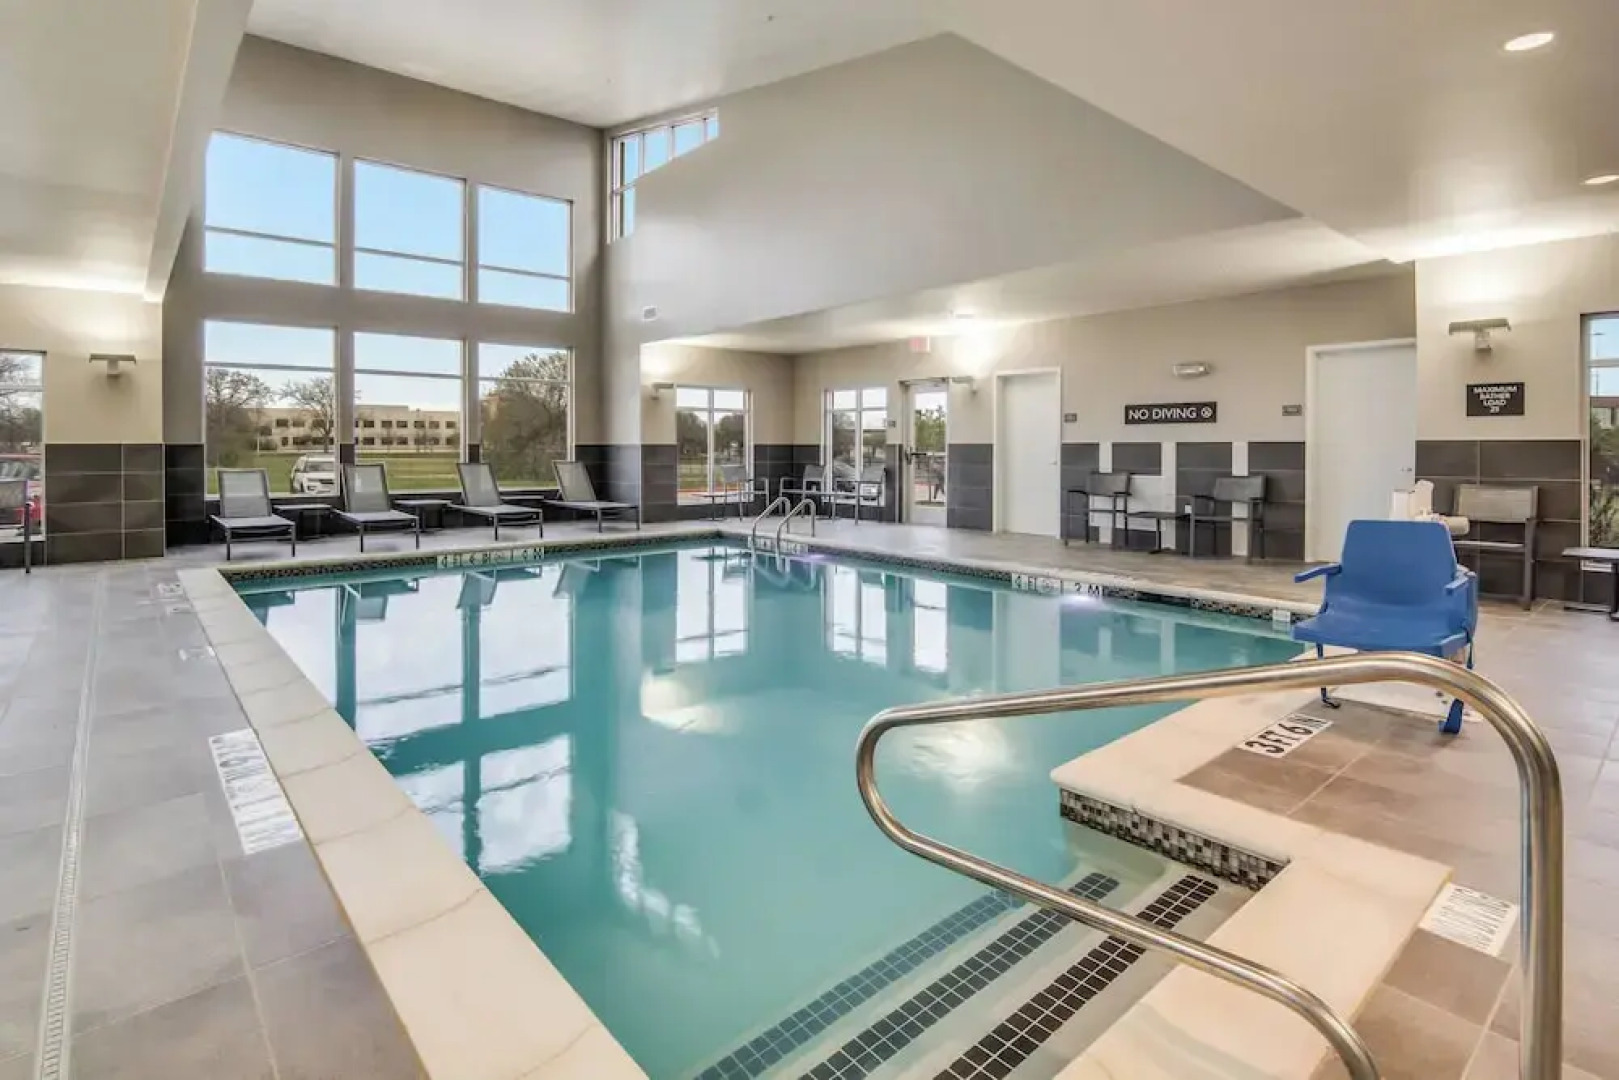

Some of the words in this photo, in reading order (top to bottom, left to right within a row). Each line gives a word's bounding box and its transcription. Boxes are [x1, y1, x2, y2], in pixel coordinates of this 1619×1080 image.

[1473, 385, 1518, 394] MAXIMUM
[1128, 409, 1149, 420] NO
[1152, 407, 1197, 419] DIVING
